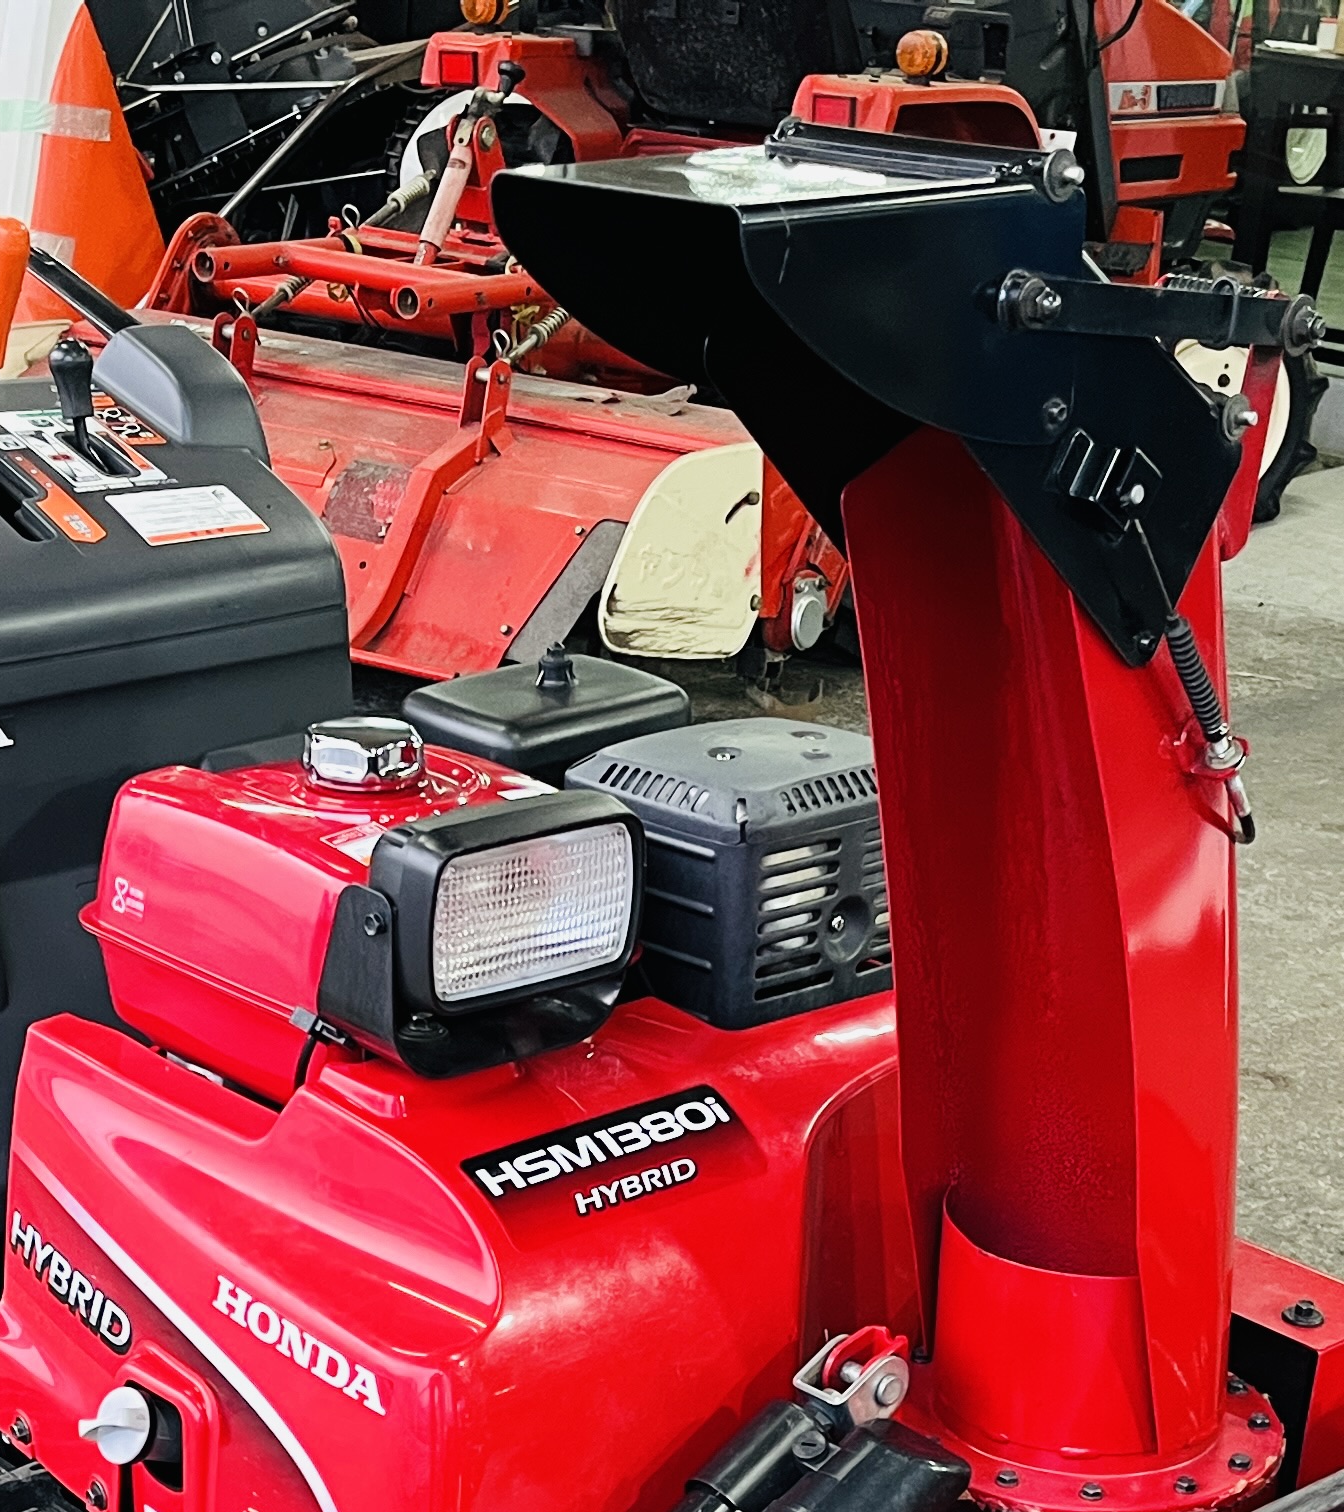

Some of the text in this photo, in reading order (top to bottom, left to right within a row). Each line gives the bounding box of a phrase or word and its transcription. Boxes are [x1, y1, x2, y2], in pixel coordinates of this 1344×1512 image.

[475, 1096, 731, 1197] HSM1380i
[575, 1158, 697, 1214] HYBRID
[10, 1211, 132, 1350] HYBRID
[212, 1275, 386, 1416] HONDA
